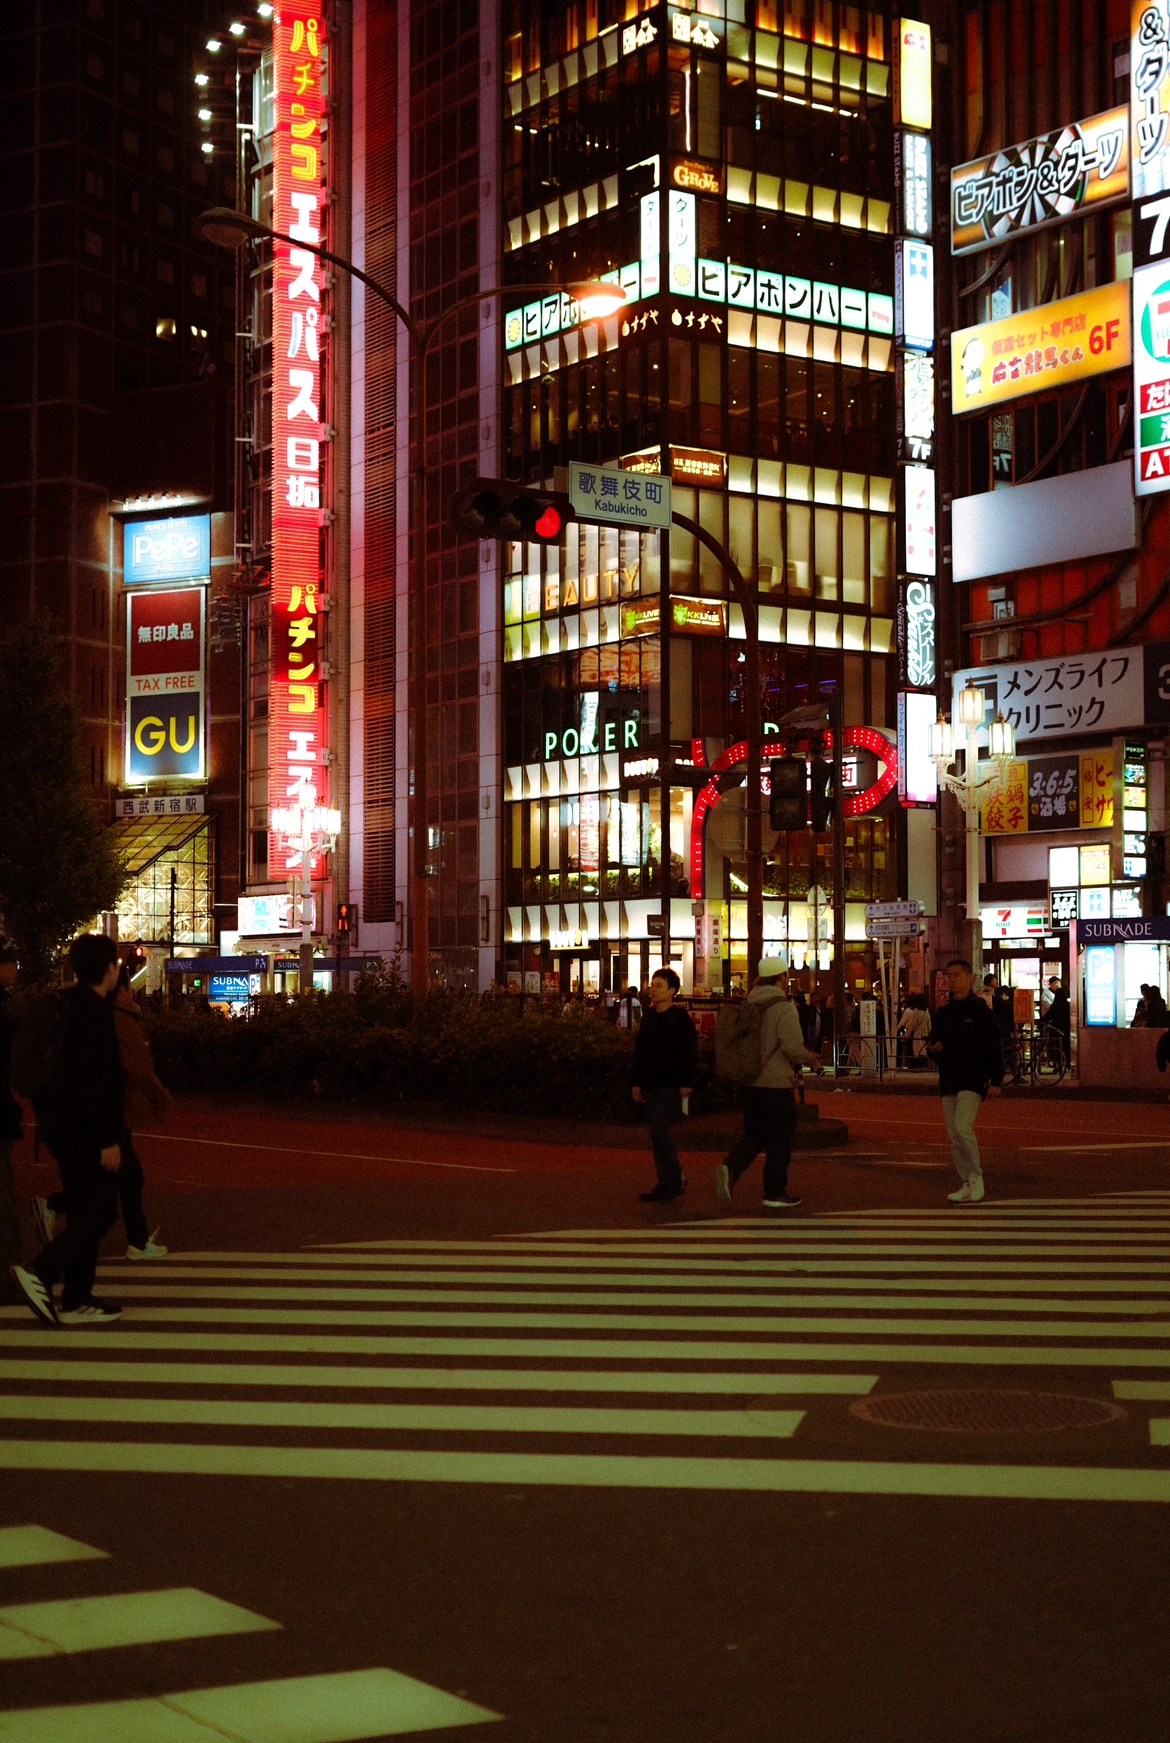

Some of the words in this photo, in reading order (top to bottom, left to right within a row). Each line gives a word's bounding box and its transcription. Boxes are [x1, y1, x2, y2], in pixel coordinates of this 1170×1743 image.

[290, 18, 319, 181] パチンコ
[673, 165, 719, 193] GROVE
[701, 266, 862, 319] ビアポンバー
[991, 314, 1087, 357] 個室セット専門店
[1088, 318, 1120, 355] 6F
[908, 437, 932, 460] 7F
[578, 472, 663, 504] 歌舞伎町
[594, 498, 648, 517] Kabukicho
[135, 533, 199, 564] PePe
[525, 565, 639, 616] BEAUTY
[137, 622, 195, 644] 無印良品
[287, 583, 318, 714] パチンコ
[135, 677, 161, 693] TAX
[165, 675, 195, 690] FREE
[1003, 656, 1130, 699] メンズライフ
[1005, 696, 1105, 734] クリニック
[134, 715, 196, 757] GU
[545, 720, 639, 759] POKER
[122, 797, 198, 815] 西武新宿駅
[984, 806, 1025, 831] 餃子
[1039, 794, 1067, 817] 酒場
[1085, 922, 1153, 938] SUBNADE
[167, 960, 193, 971] SUBNADE
